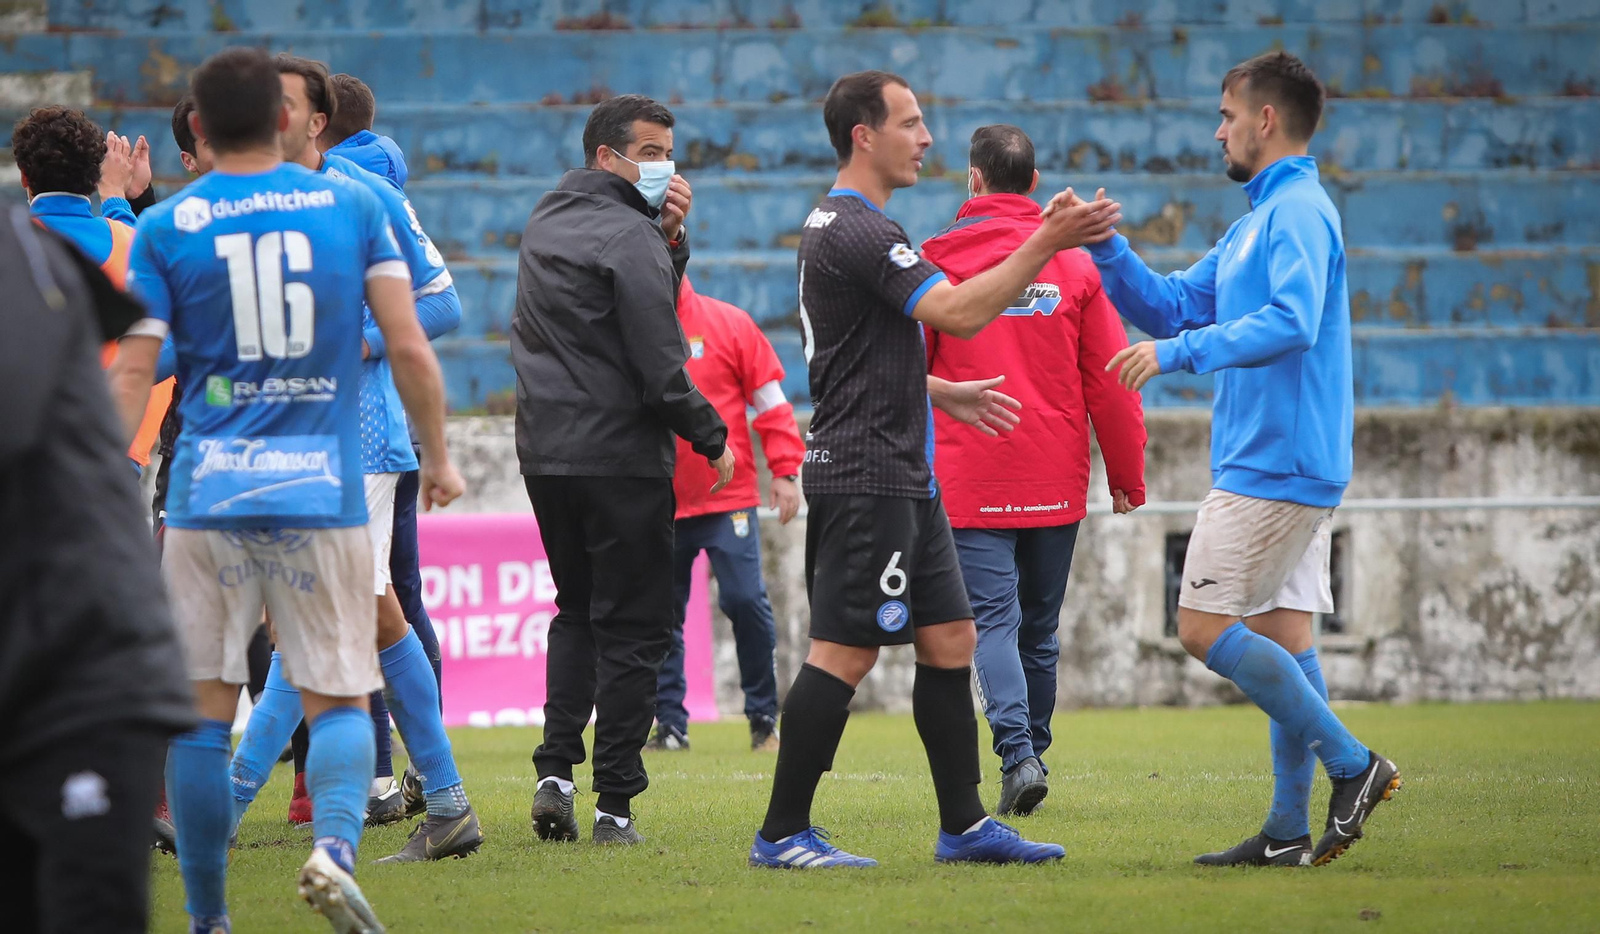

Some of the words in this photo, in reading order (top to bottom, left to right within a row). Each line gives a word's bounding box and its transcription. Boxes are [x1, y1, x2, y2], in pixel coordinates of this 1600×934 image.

[212, 189, 335, 219] duokitchen
[214, 231, 316, 361] 16
[879, 551, 907, 596] 6
